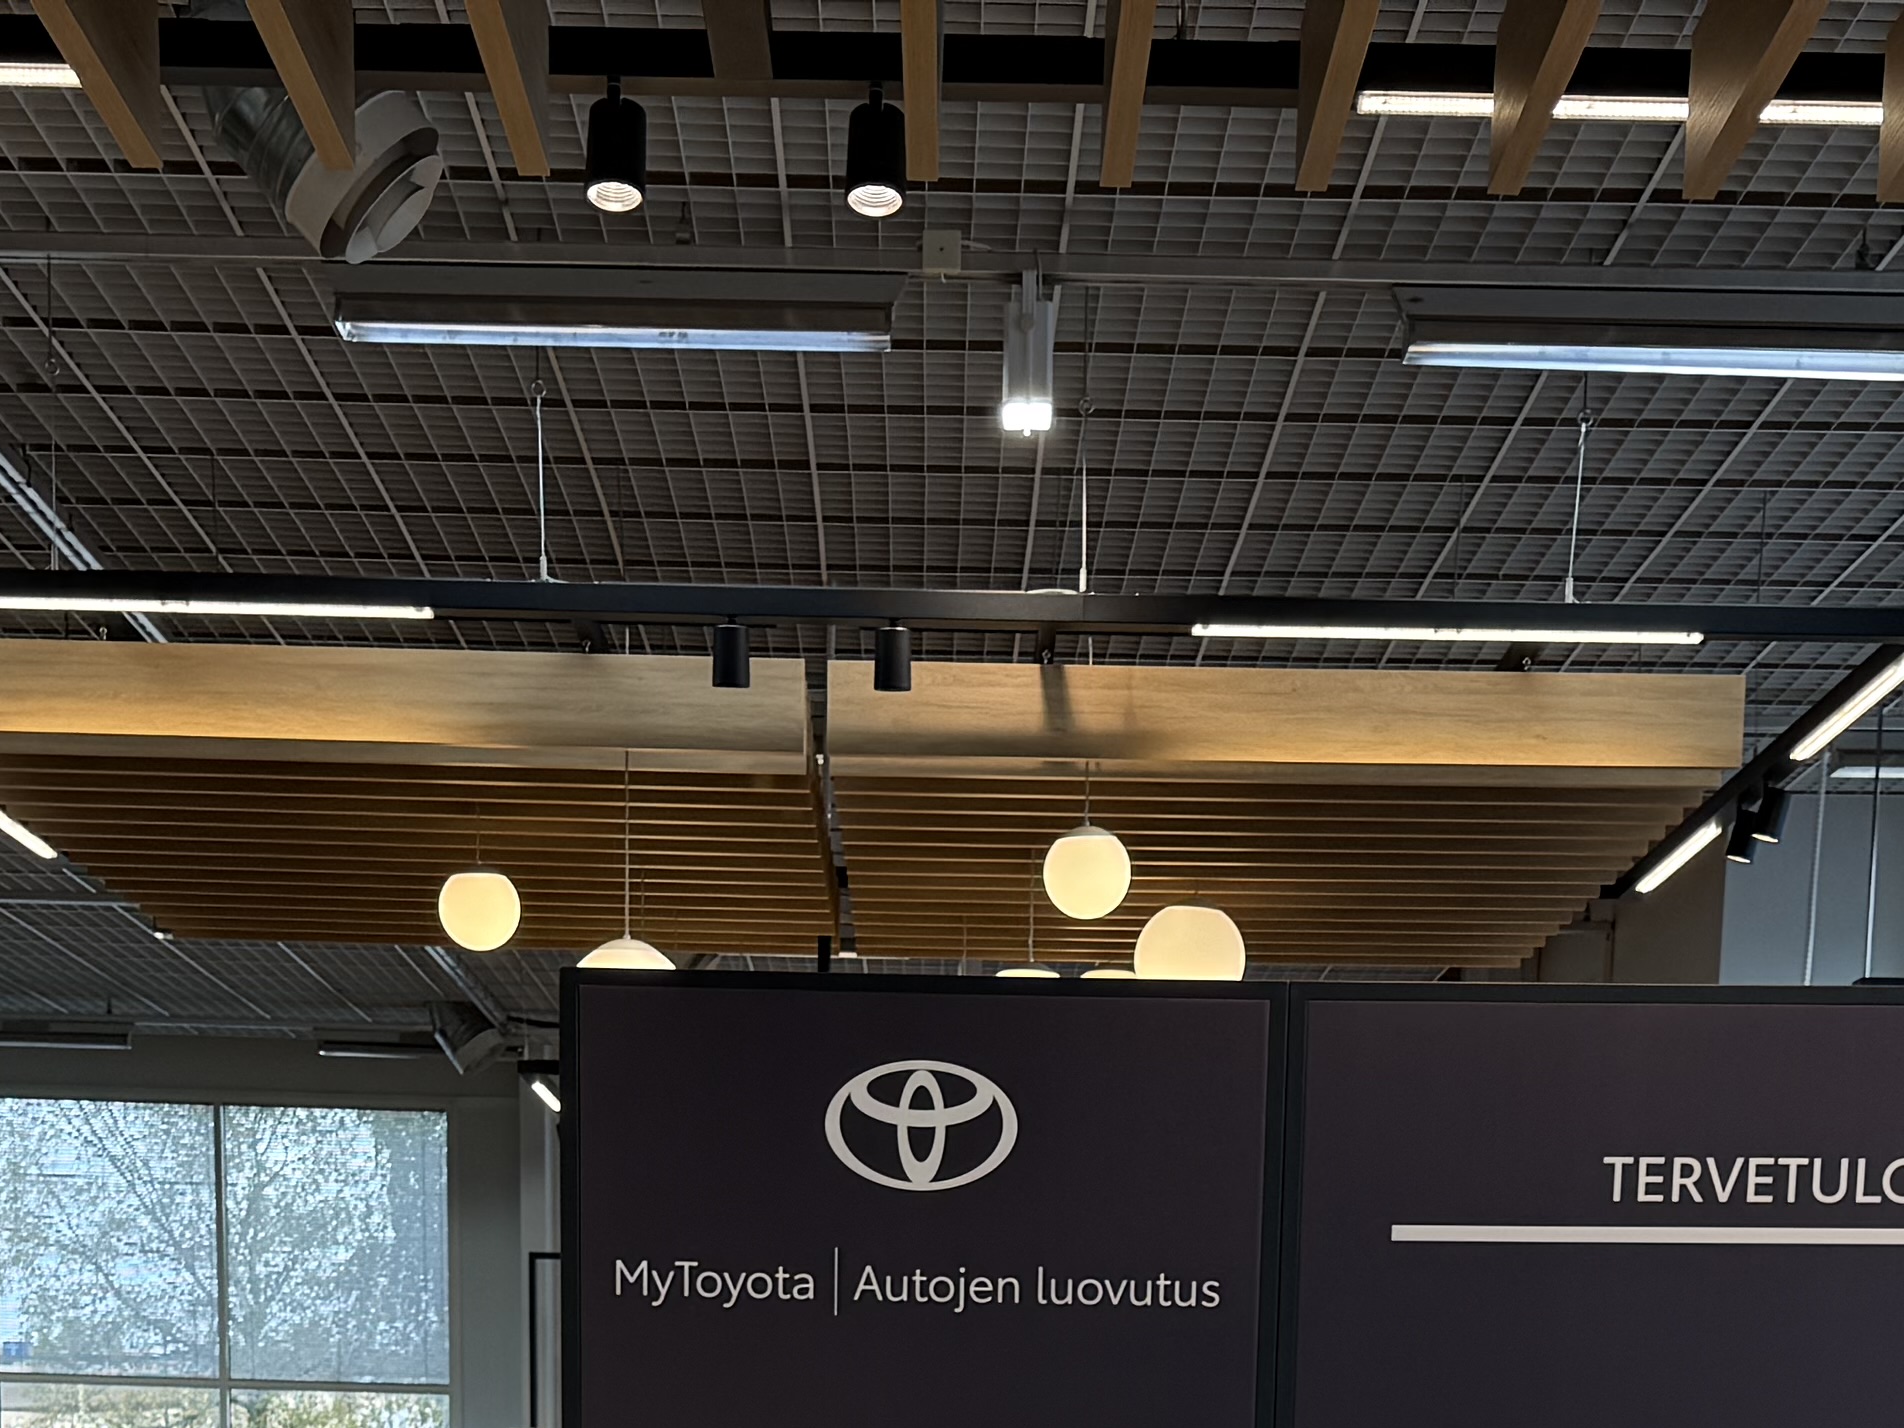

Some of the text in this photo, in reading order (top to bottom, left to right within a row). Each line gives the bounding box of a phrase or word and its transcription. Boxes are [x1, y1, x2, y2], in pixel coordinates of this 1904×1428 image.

[614, 1259, 1221, 1313] MyToyota Autojen luovutus
